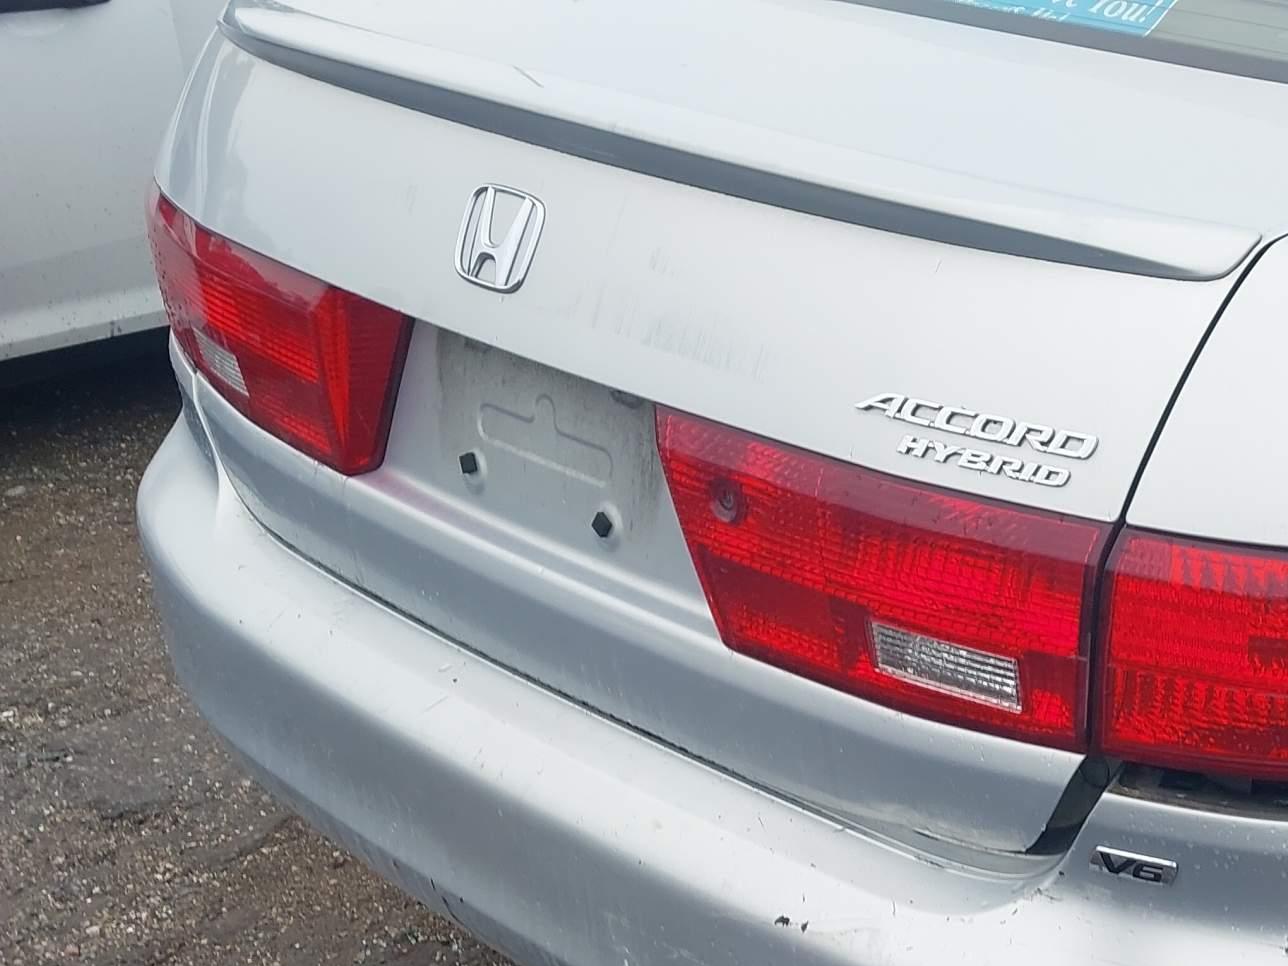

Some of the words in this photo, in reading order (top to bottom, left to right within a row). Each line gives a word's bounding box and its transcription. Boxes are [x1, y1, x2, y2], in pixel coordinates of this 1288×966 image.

[854, 392, 1099, 460] ACCORD
[897, 435, 1071, 488] HYBRID
[1098, 848, 1165, 883] V6
